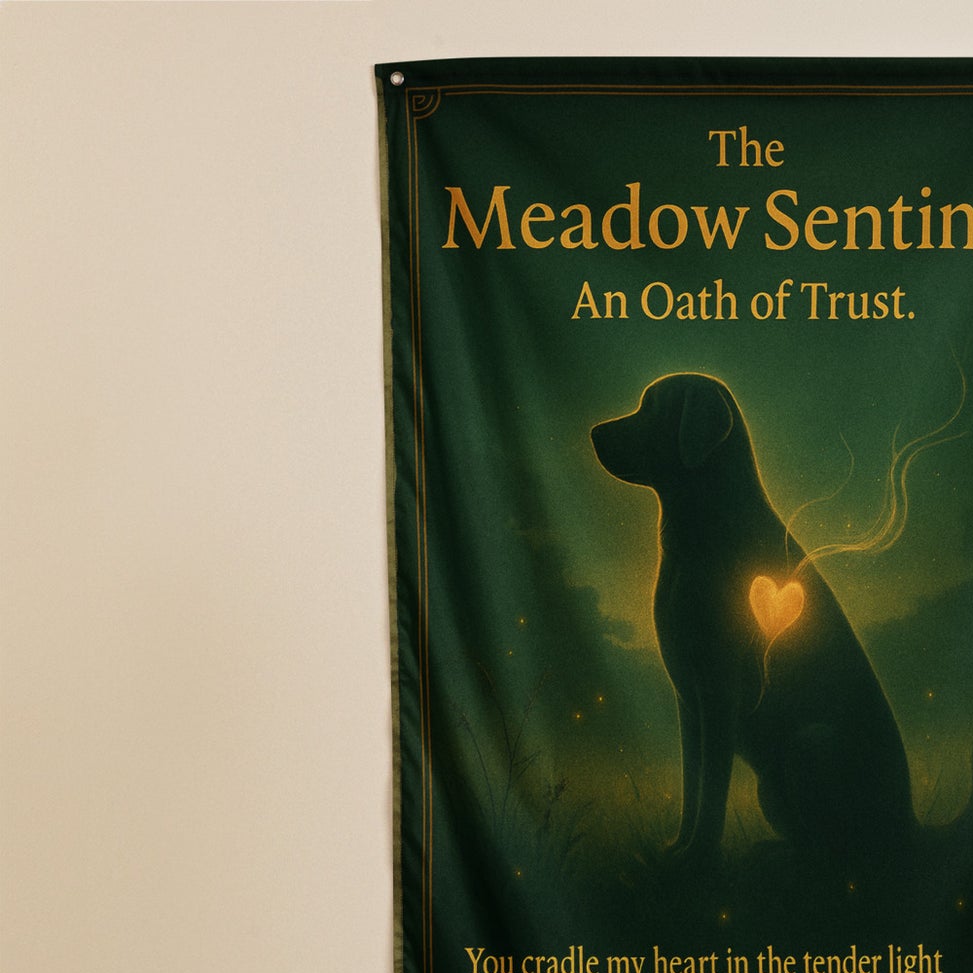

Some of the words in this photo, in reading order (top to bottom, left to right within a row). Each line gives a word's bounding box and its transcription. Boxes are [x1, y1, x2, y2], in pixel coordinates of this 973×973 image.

[708, 126, 784, 167] The
[442, 182, 750, 250] Meadow
[571, 281, 629, 320] An
[641, 279, 737, 320] Oath
[750, 279, 793, 320] of
[801, 281, 916, 320] Trust.
